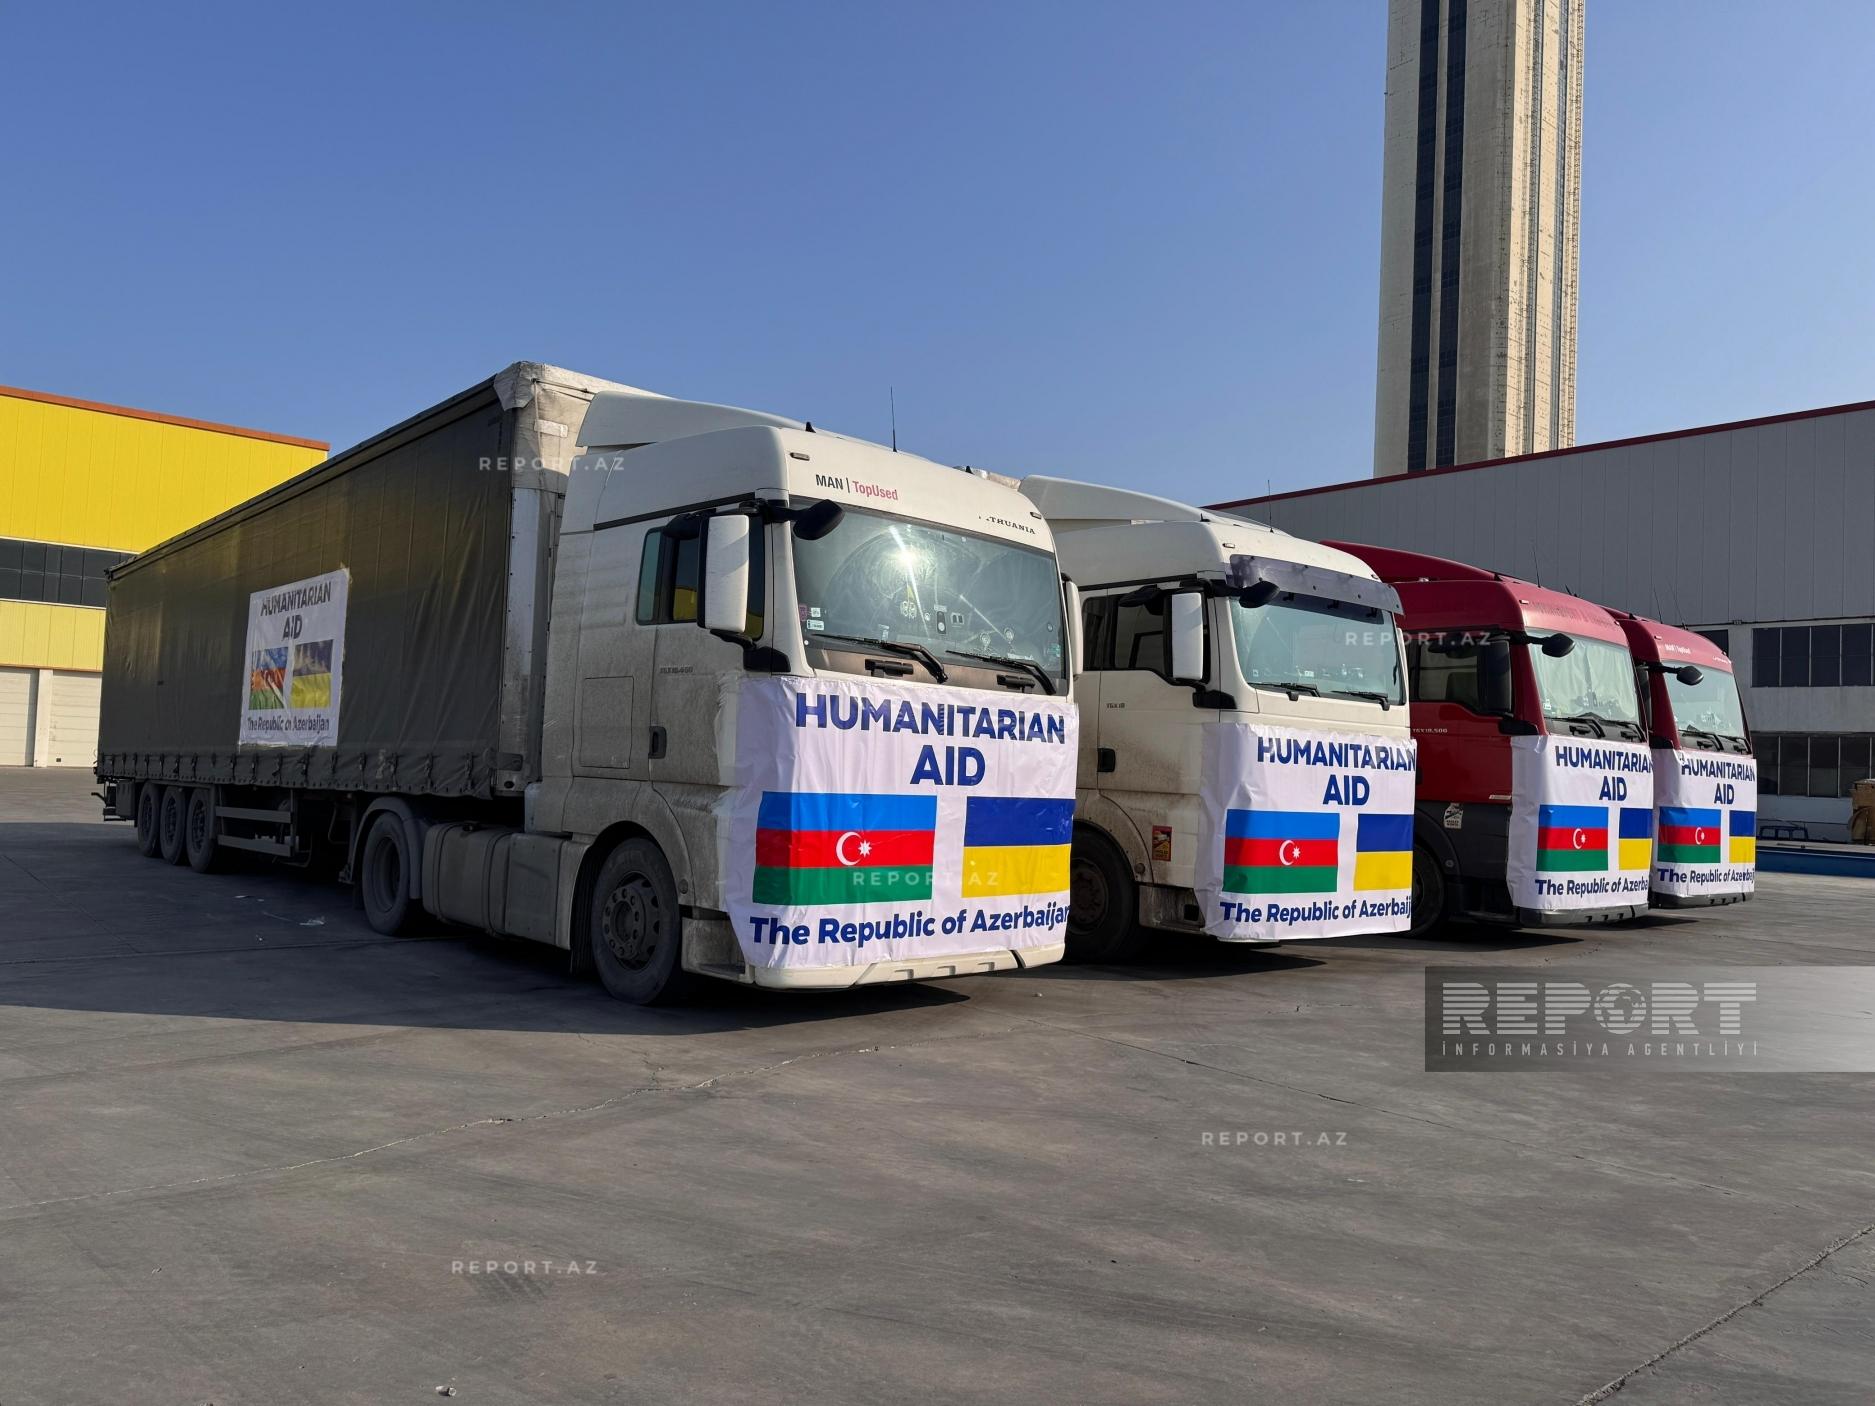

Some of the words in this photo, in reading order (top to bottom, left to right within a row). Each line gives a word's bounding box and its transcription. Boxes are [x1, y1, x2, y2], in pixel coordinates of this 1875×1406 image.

[815, 474, 844, 490] MAN
[852, 480, 899, 501] TopUsed
[979, 515, 1036, 535] THUANIA
[260, 581, 331, 616] HUMANITARIAN
[281, 614, 303, 641] AID
[795, 692, 1065, 744] HUMANITARIAN
[909, 744, 986, 786] AID
[1257, 736, 1416, 772] HUMANITARIAN
[1322, 774, 1370, 806] AID
[1598, 776, 1628, 801] AID
[1713, 782, 1735, 805] AID
[1535, 878, 1564, 895] The
[1566, 877, 1610, 898] Republic
[1610, 877, 1622, 893] of
[1657, 868, 1688, 883] The
[1689, 869, 1722, 886] Republic
[1723, 868, 1731, 882] of
[1219, 901, 1263, 923] The
[1266, 900, 1340, 926] Republic
[1342, 899, 1357, 919] of
[750, 916, 810, 945] The
[818, 911, 935, 948] Republic
[941, 908, 967, 935] of
